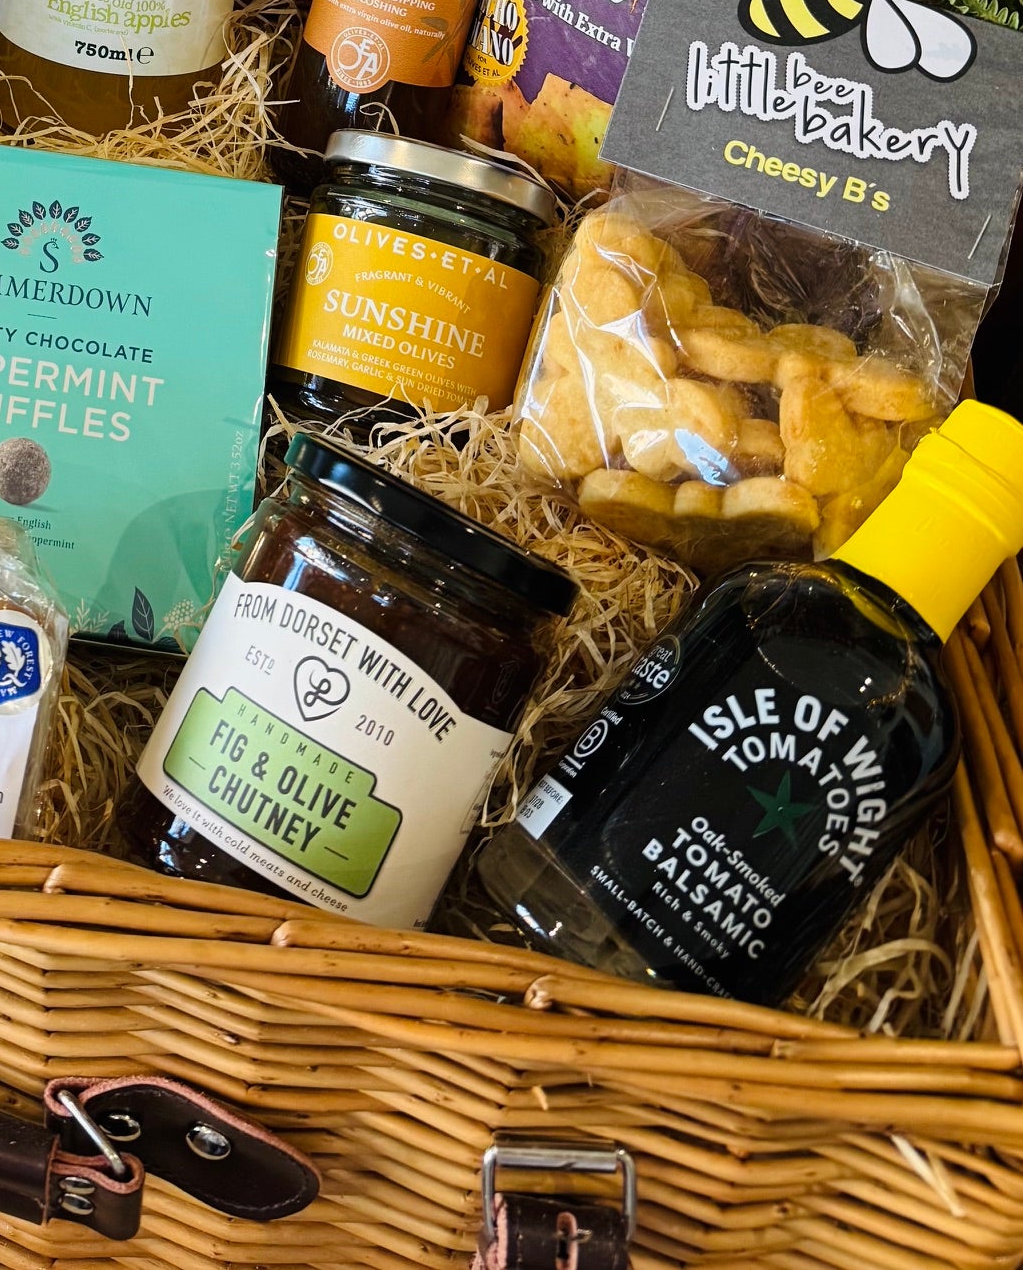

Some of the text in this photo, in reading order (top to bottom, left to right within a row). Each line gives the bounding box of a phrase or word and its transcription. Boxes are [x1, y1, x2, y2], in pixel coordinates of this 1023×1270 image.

[124, 10, 192, 35] apples
[336, 1, 357, 15] extra
[575, 11, 621, 52] Extra
[693, 47, 970, 193] little bee bakery
[723, 139, 837, 199] Cheesy
[354, 269, 471, 315] FRAGRANT VIBRANT
[25, 330, 155, 365] CHOCOLATE
[323, 288, 486, 358] SUNSHINE
[343, 324, 456, 369] MIXED OLIVES
[417, 382, 445, 399] DRIED
[456, 381, 477, 396] WITH
[17, 515, 51, 531] English
[279, 605, 457, 744] DORSET WITH LOVE
[237, 703, 355, 785] HANDMADE
[688, 687, 850, 753] ISLE OF
[162, 784, 193, 815] We love
[207, 764, 321, 854] CHUTNEY
[277, 768, 357, 830] OLIVE
[721, 731, 850, 858] TOMATOES
[672, 827, 772, 929] TOMATO
[691, 816, 786, 907] Oak-Smoked
[590, 865, 665, 938] SMALL-BATCH
[641, 838, 765, 960] BALSAMIC
[693, 921, 730, 960] Smoky
